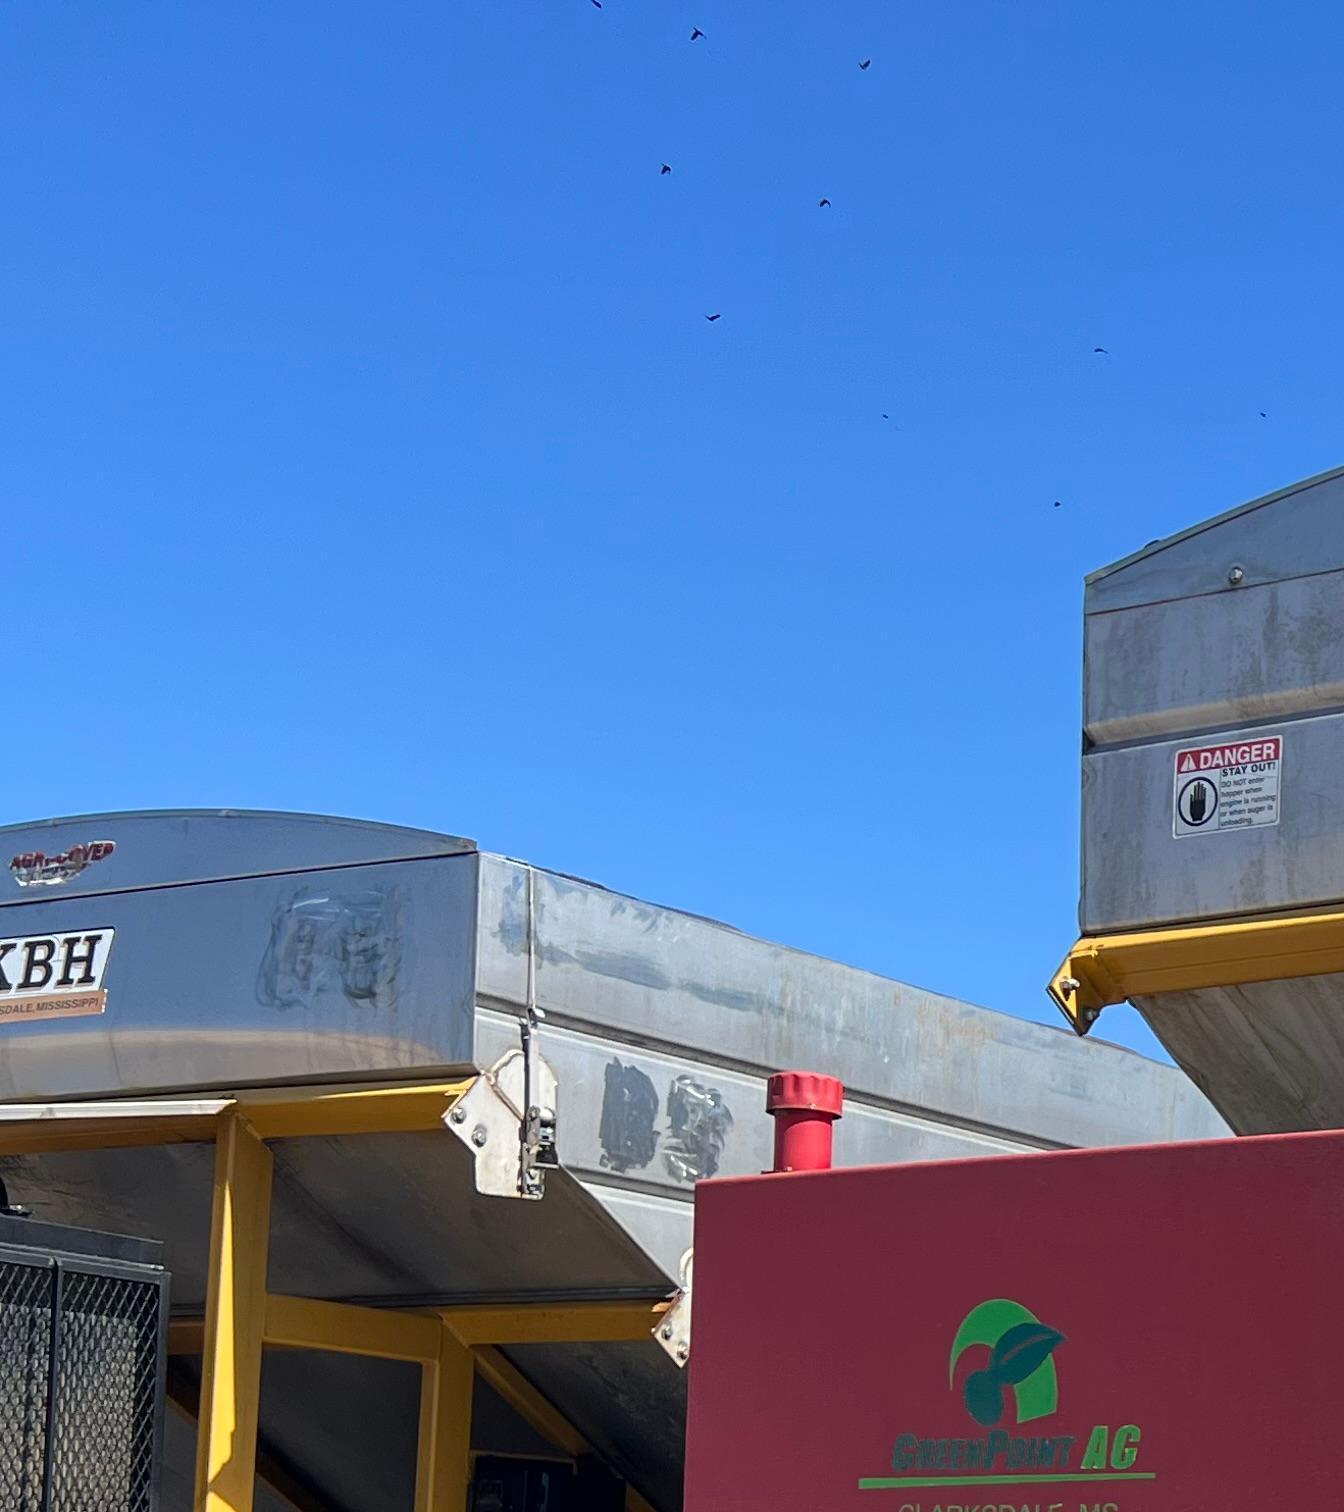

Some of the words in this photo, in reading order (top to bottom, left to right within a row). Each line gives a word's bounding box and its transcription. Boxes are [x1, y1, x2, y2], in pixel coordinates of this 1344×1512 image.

[1200, 742, 1275, 769] DANGER
[1222, 766, 1247, 778] STAY
[1251, 761, 1276, 773] OUT!
[36, 998, 99, 1011] MISSISSIPPI
[1080, 1424, 1142, 1470] AG
